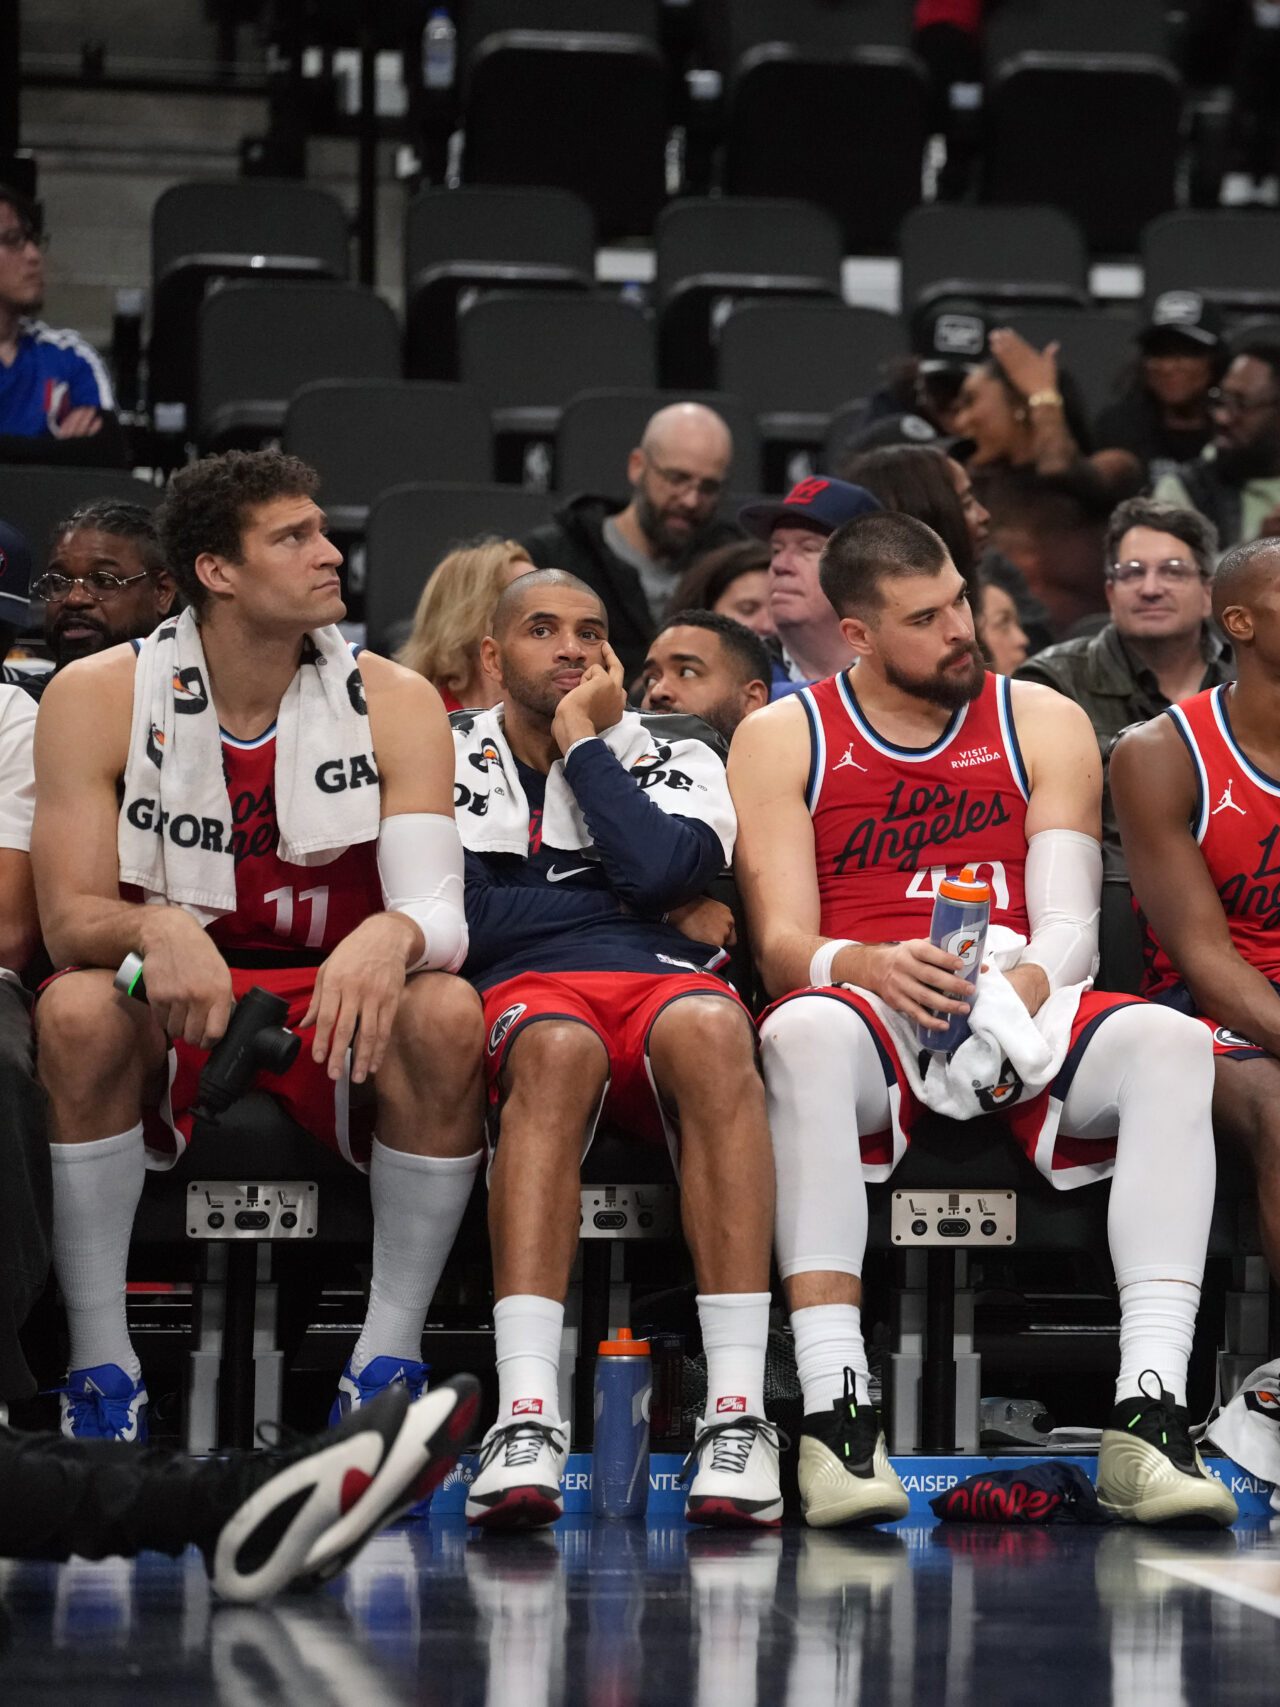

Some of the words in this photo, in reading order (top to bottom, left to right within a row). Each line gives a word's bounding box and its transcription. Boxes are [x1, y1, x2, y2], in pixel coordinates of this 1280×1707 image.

[951, 752, 1001, 768] RWANDA
[959, 747, 988, 759] VISIT
[882, 779, 955, 824] Los
[832, 788, 1012, 876] Angeles
[263, 885, 330, 948] 11
[898, 1475, 958, 1492] KAISER
